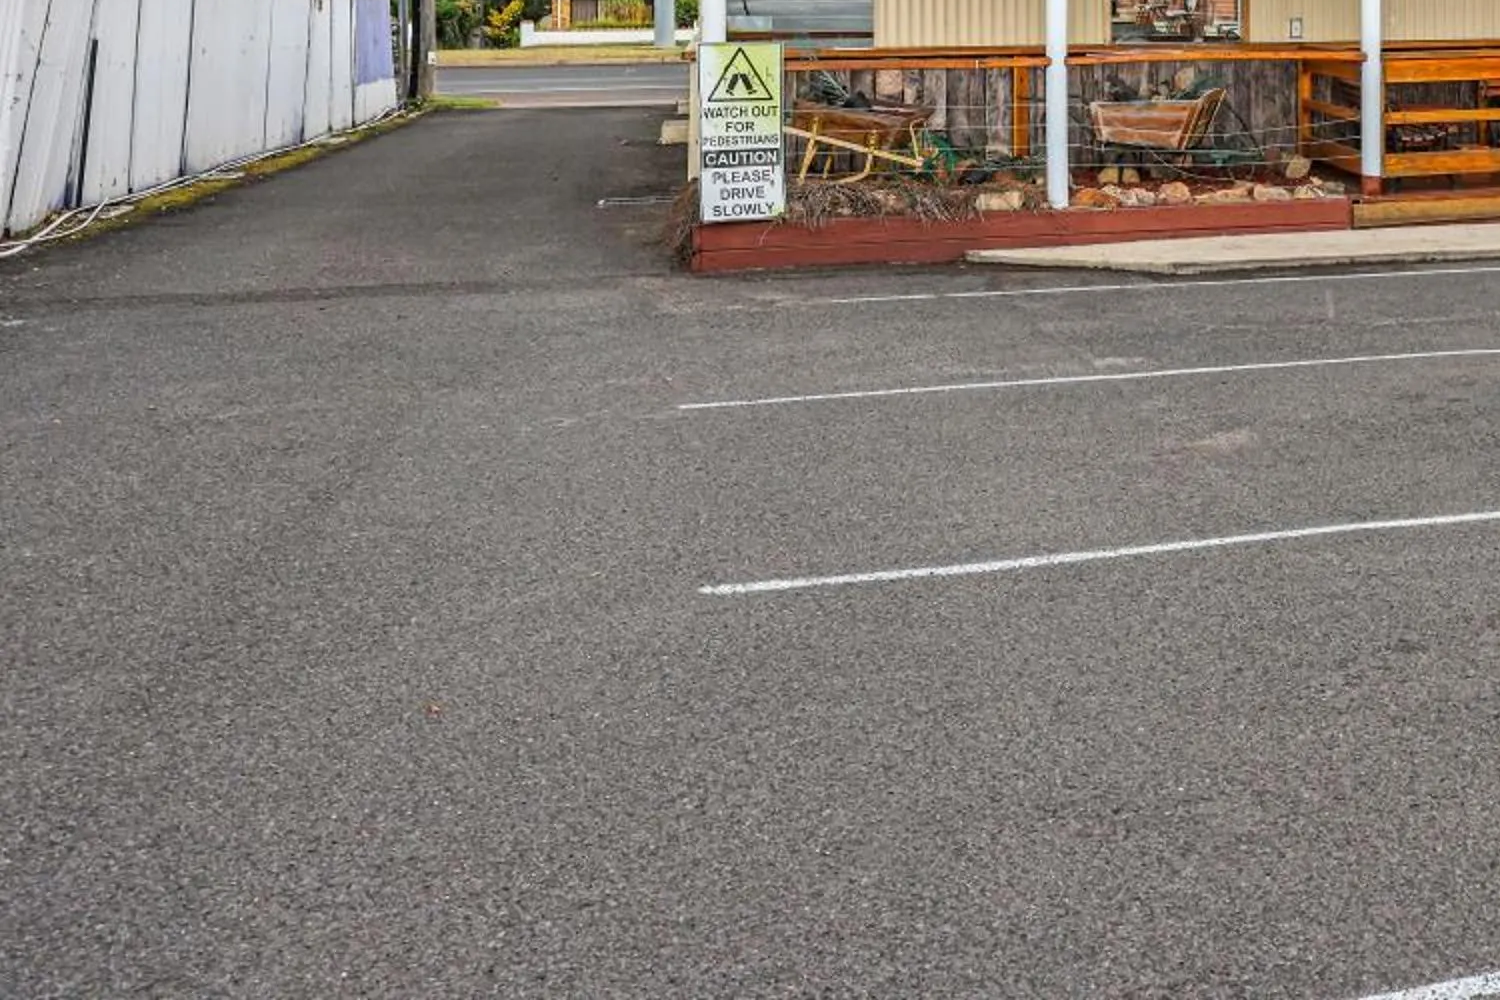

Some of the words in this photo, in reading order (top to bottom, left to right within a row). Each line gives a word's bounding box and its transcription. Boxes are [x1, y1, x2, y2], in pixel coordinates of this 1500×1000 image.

[703, 106, 748, 119] WATCH
[751, 105, 779, 117] OUT
[725, 121, 755, 132] FOR
[703, 133, 778, 147] PEDESTRIANS
[706, 151, 777, 165] CAUTION
[720, 186, 765, 200] DRIVE
[713, 202, 775, 217] SLOWLY
